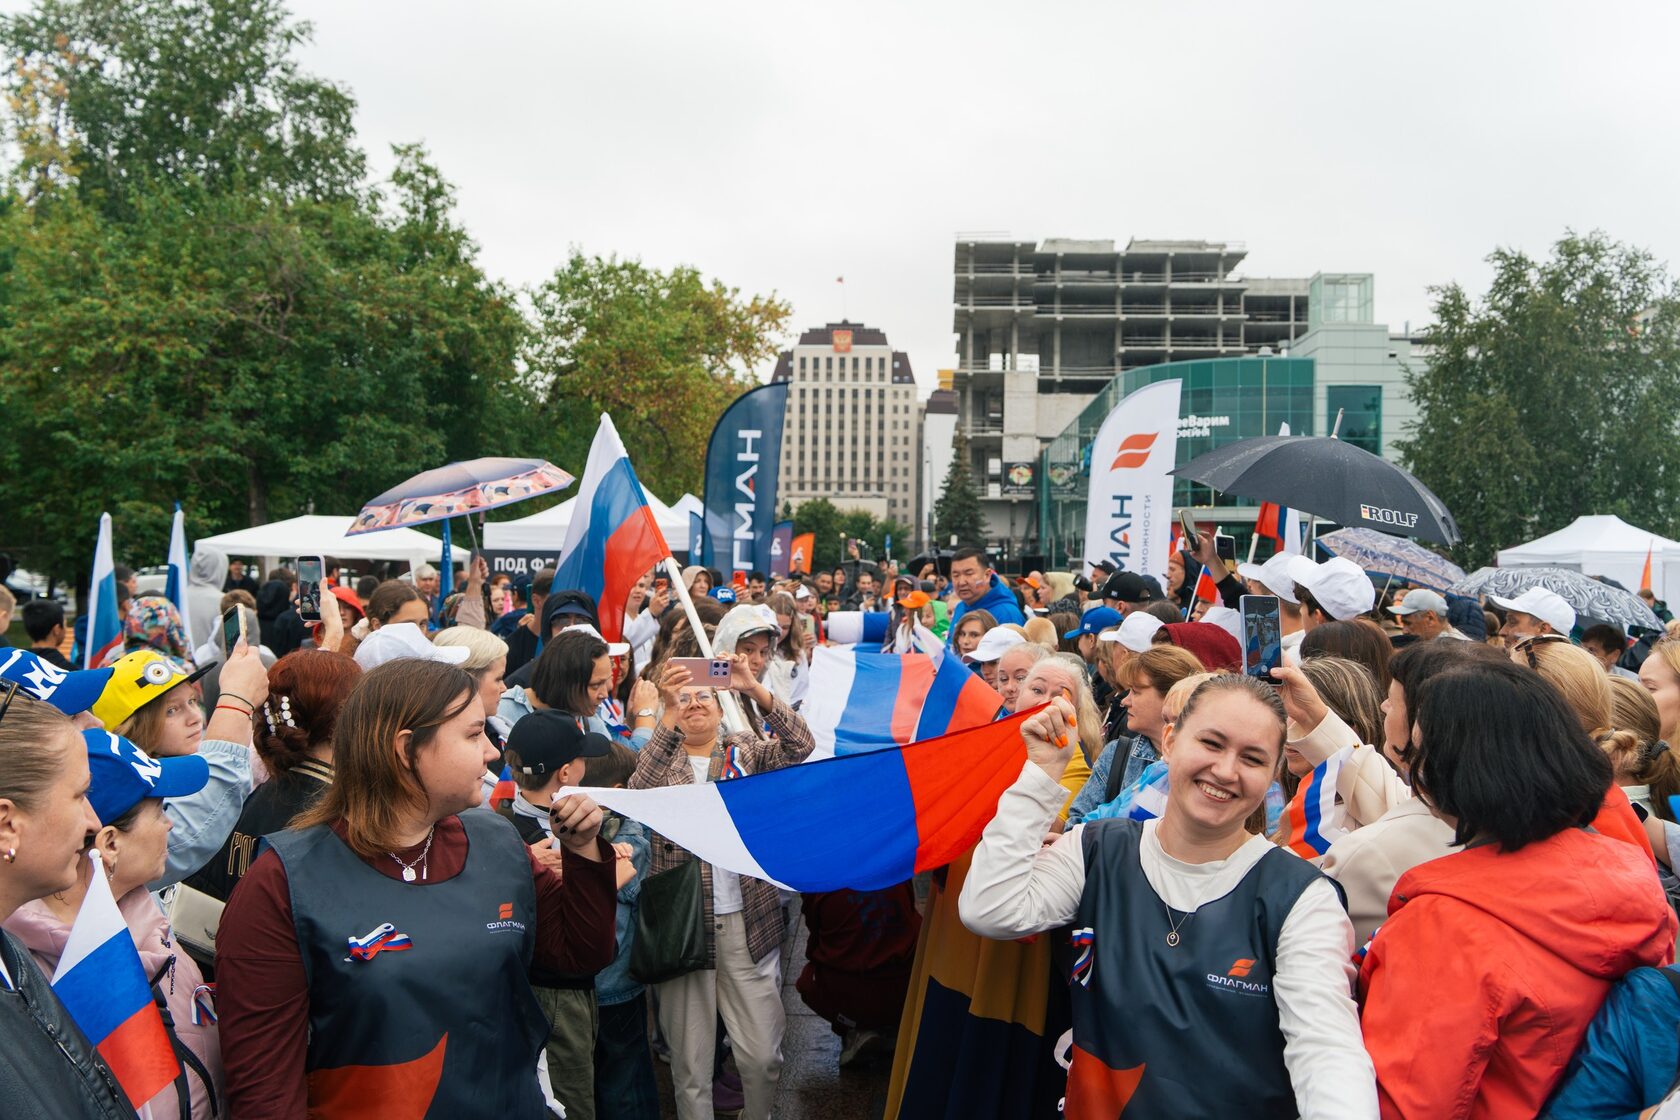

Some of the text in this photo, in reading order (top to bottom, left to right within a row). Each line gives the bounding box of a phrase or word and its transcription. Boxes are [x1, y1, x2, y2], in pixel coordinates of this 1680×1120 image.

[1367, 505, 1418, 528] ROLF
[494, 557, 528, 574] ПОД
[530, 557, 555, 571] Ф
[486, 920, 526, 930] ФЛАГМАН
[1206, 973, 1268, 992] ФЛАГМАН
